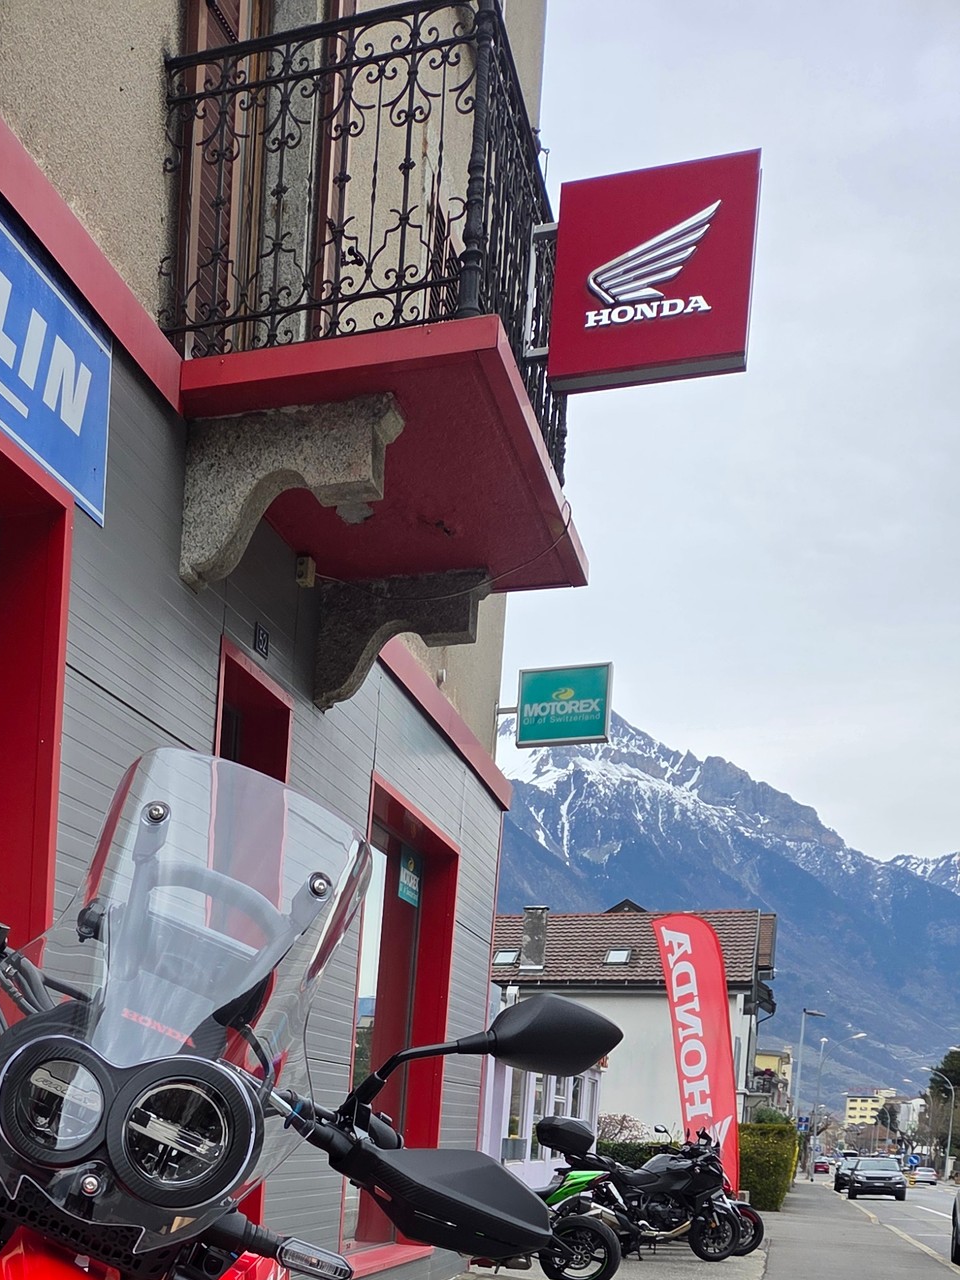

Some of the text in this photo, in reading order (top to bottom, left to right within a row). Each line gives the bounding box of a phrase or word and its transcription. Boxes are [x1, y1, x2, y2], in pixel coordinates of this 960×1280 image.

[584, 295, 712, 328] HONDA
[523, 698, 601, 717] MOTOREX
[523, 712, 601, 725] Oil of Switzerland
